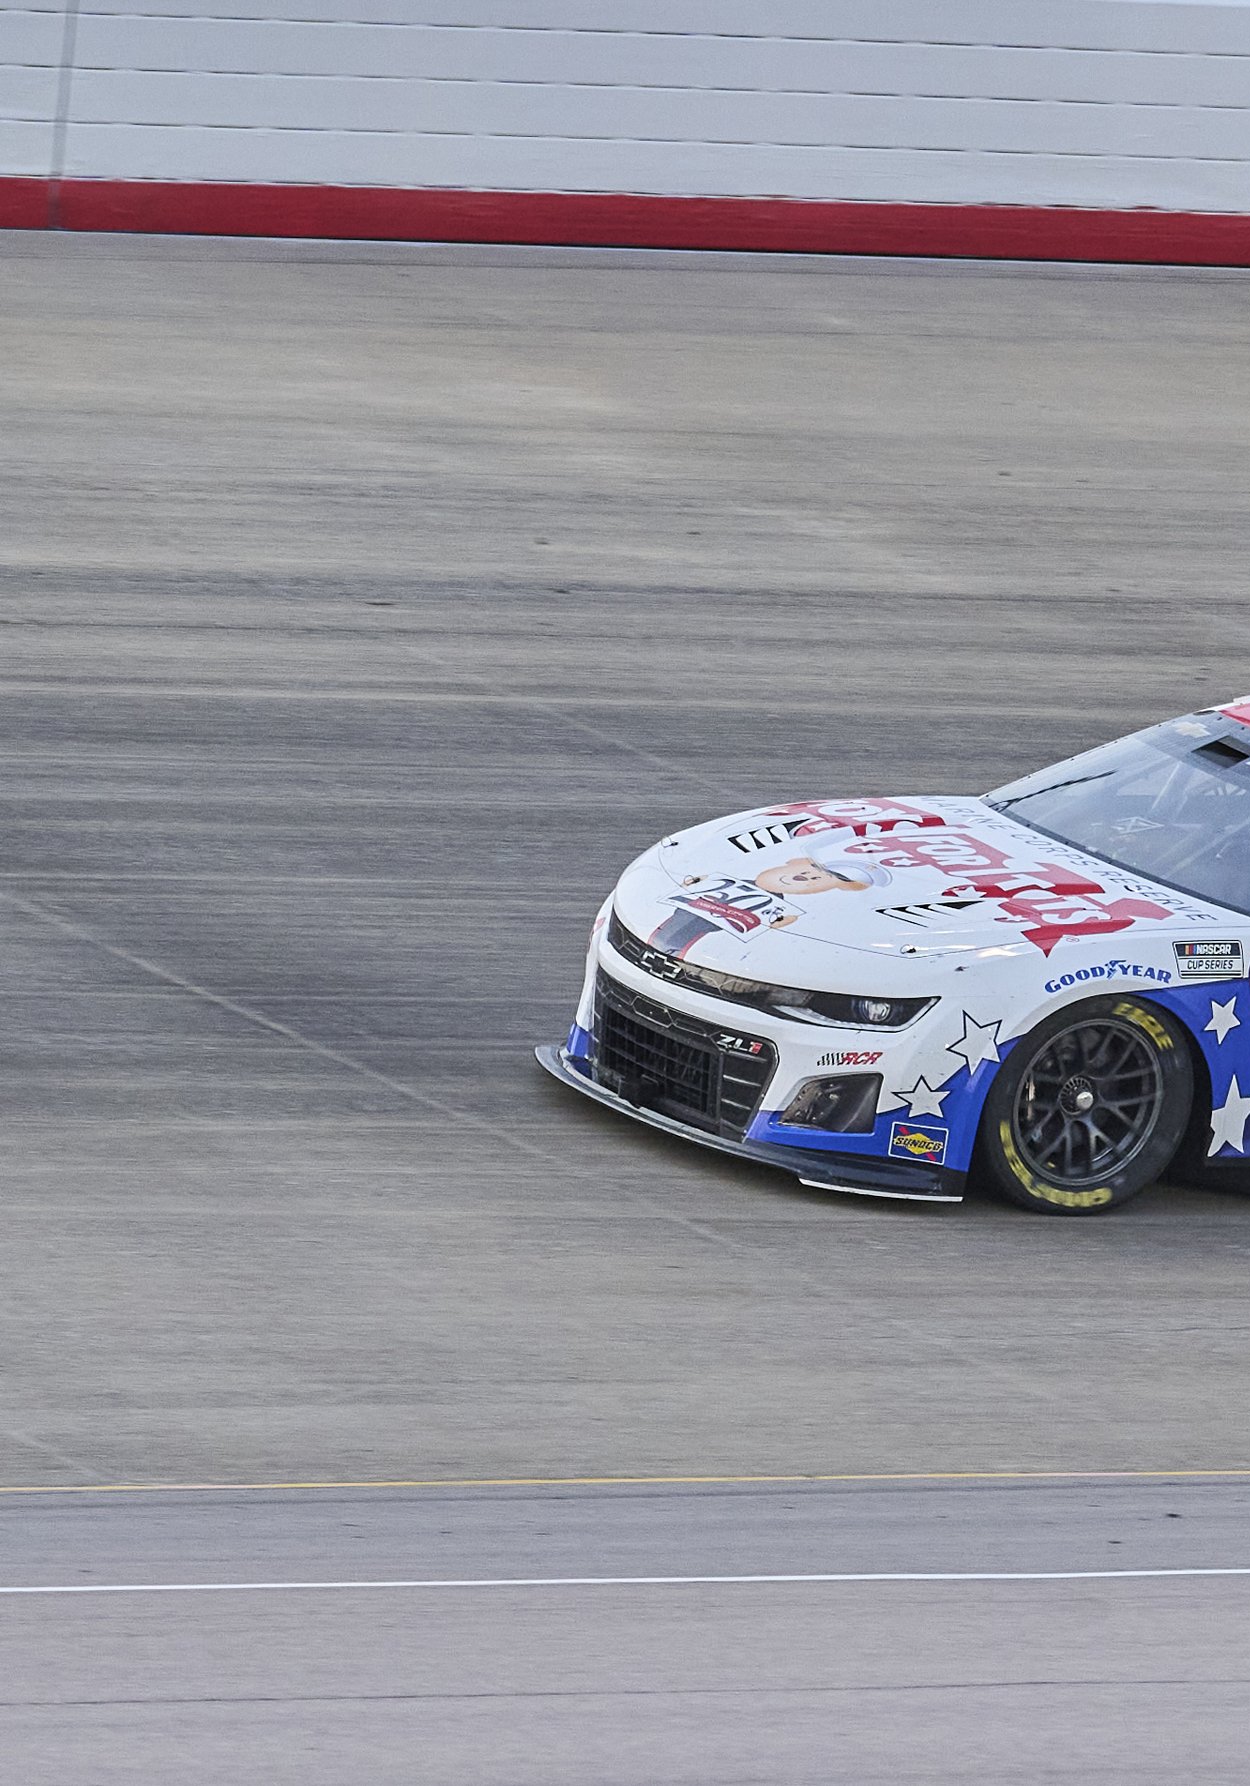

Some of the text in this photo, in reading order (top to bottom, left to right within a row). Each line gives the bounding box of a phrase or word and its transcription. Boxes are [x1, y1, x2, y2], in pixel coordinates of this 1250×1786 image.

[1011, 833, 1099, 867] CORPS
[1093, 870, 1219, 921] RESERVE
[1196, 944, 1232, 955] NASCAR
[1187, 959, 1234, 970] CUP SERIES
[893, 1135, 944, 1152] SUNOCO
